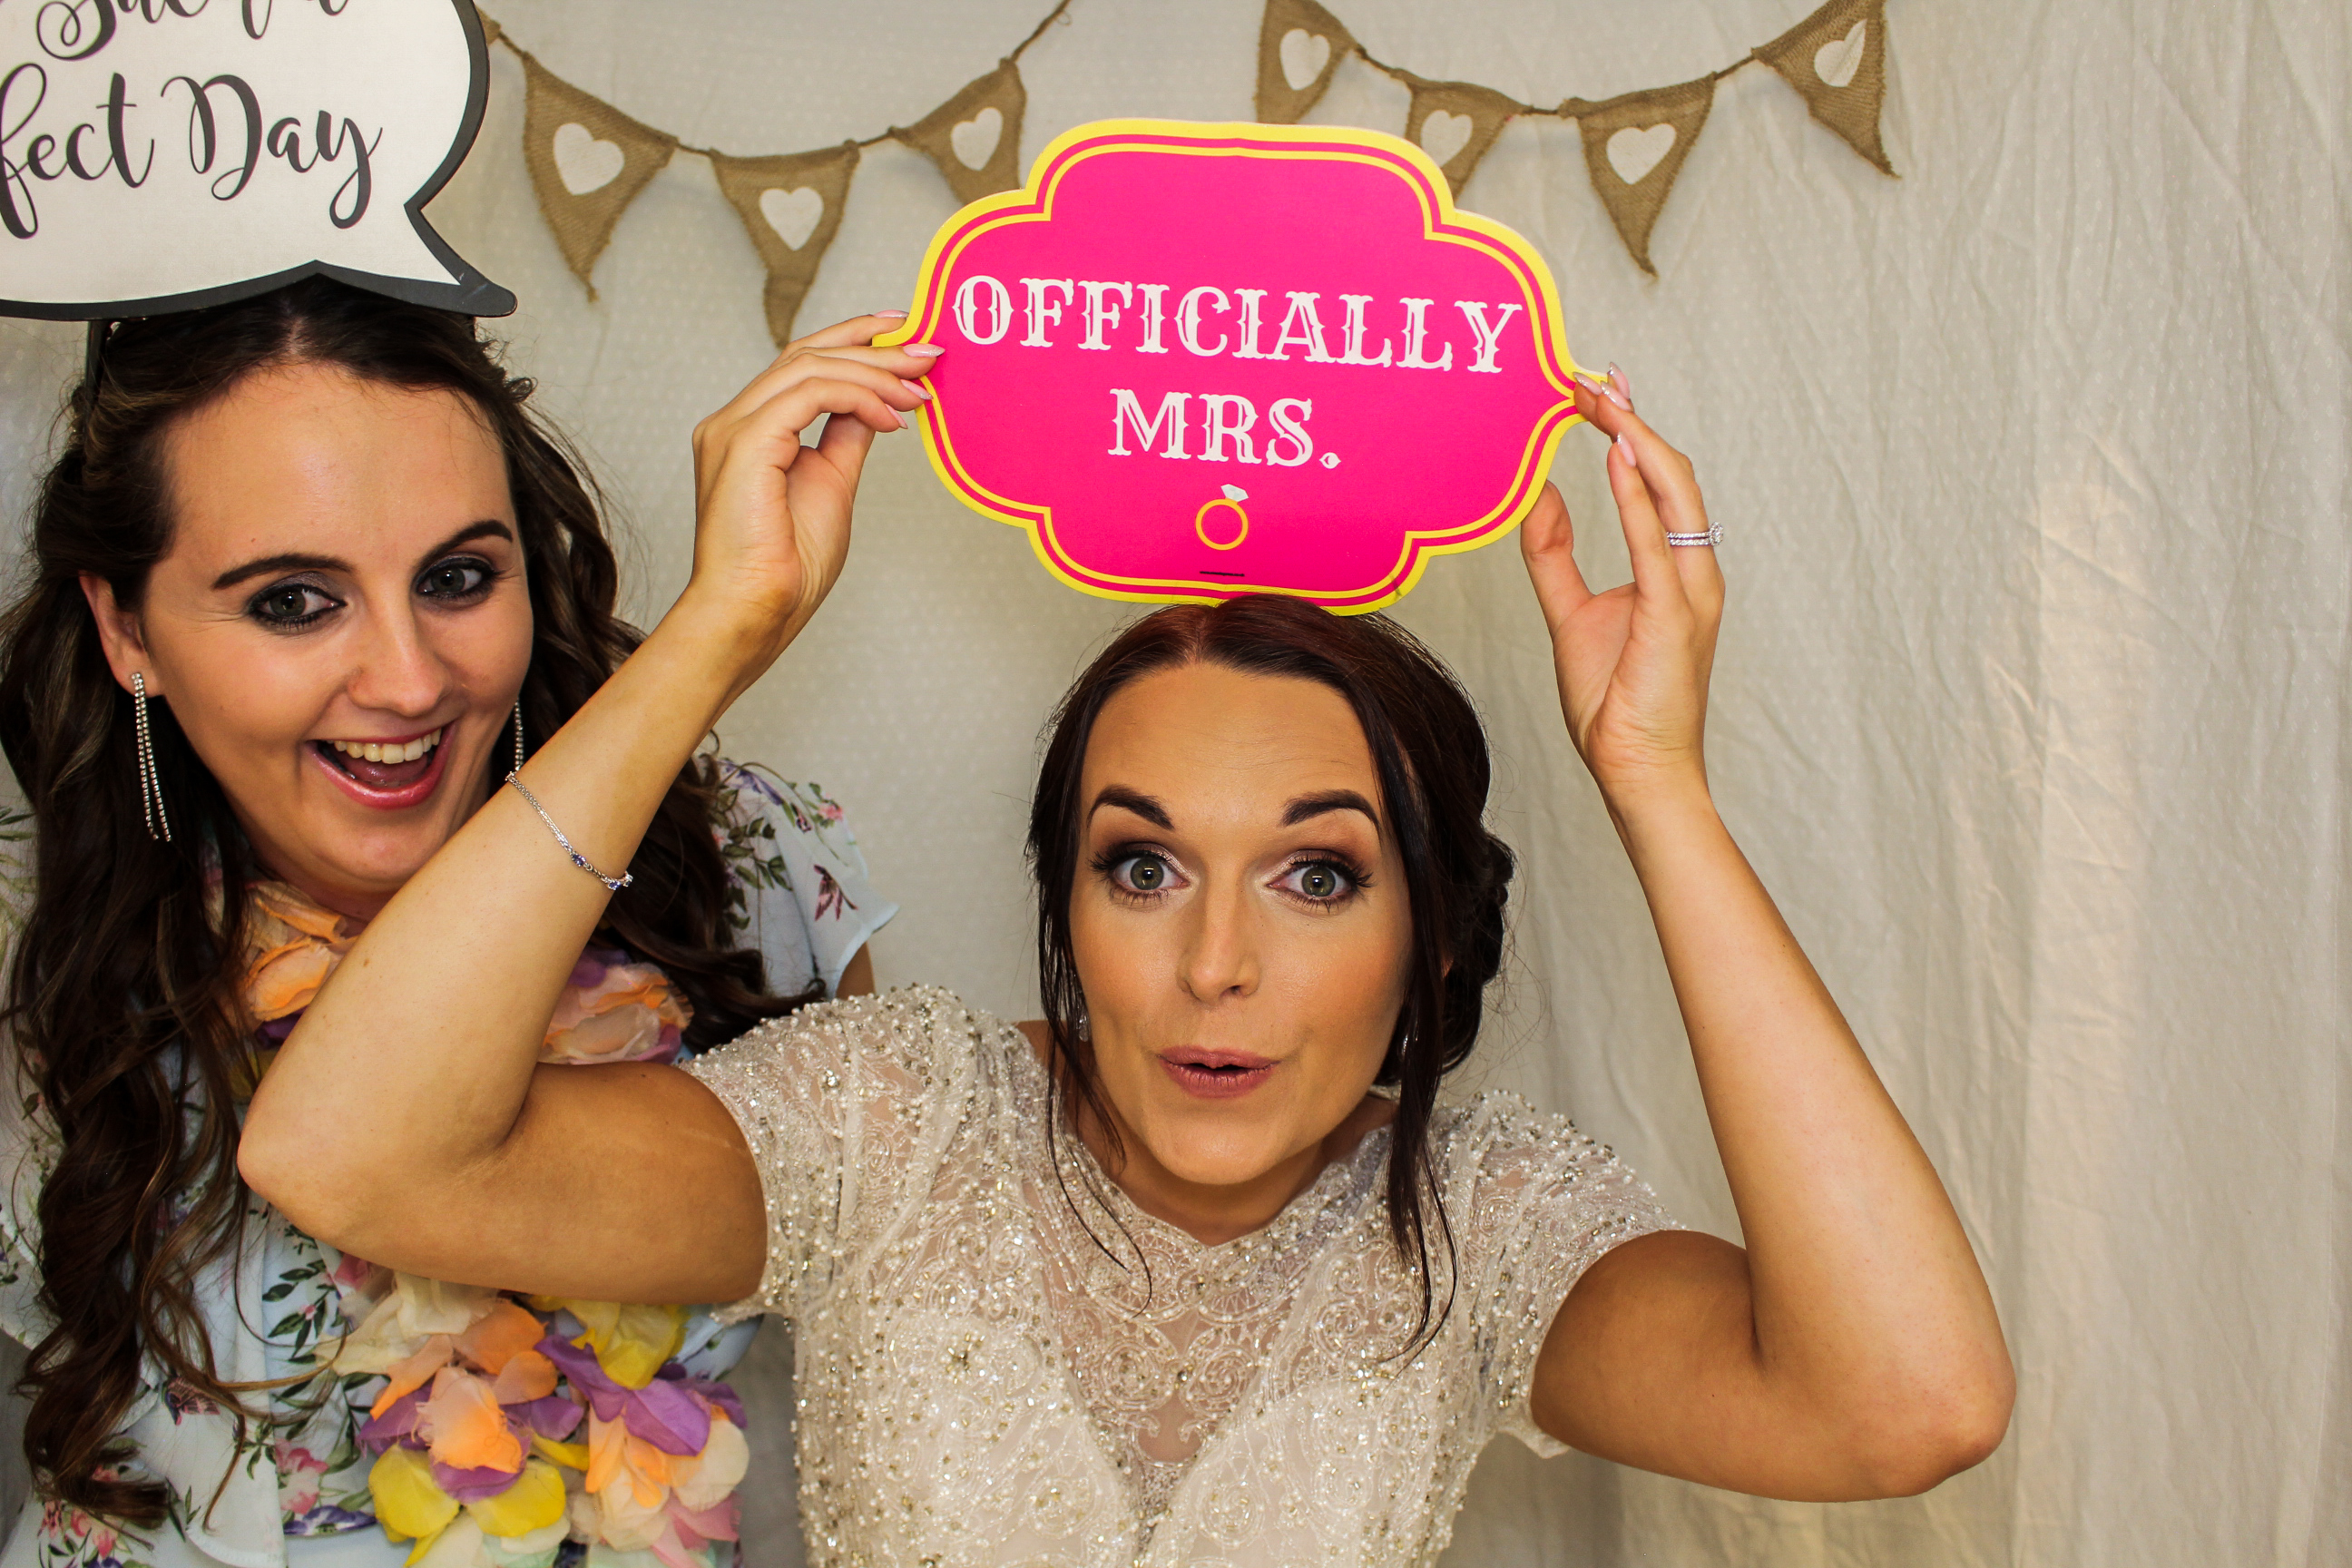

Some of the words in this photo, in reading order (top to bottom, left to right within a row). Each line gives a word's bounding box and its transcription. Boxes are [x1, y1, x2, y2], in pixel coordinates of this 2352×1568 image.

[161, 74, 383, 230] Day
[952, 275, 1524, 374] OFFICIALLY
[1107, 387, 1342, 469] MRS.
